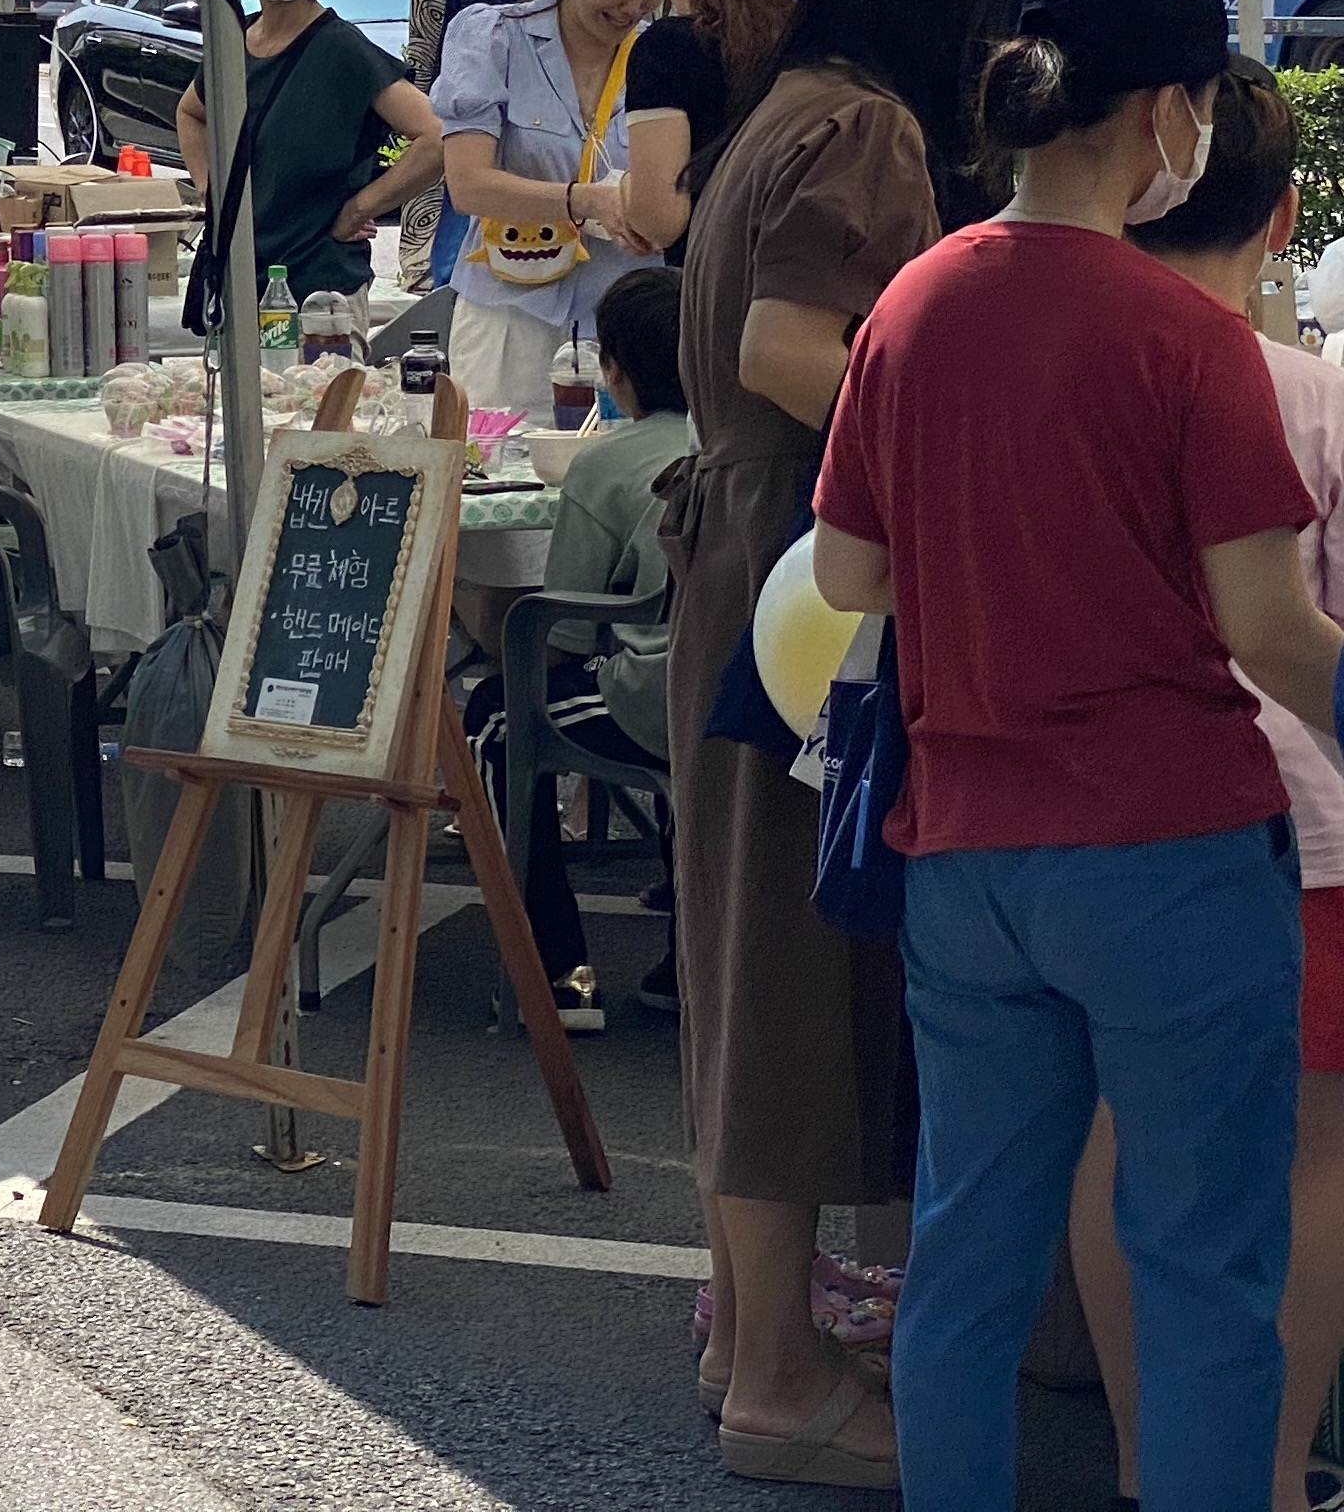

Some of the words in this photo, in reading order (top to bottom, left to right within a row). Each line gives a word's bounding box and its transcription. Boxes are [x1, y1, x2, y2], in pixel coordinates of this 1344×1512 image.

[289, 481, 330, 530] 냅킨
[326, 548, 370, 590] 체험
[297, 646, 351, 680] 판매
